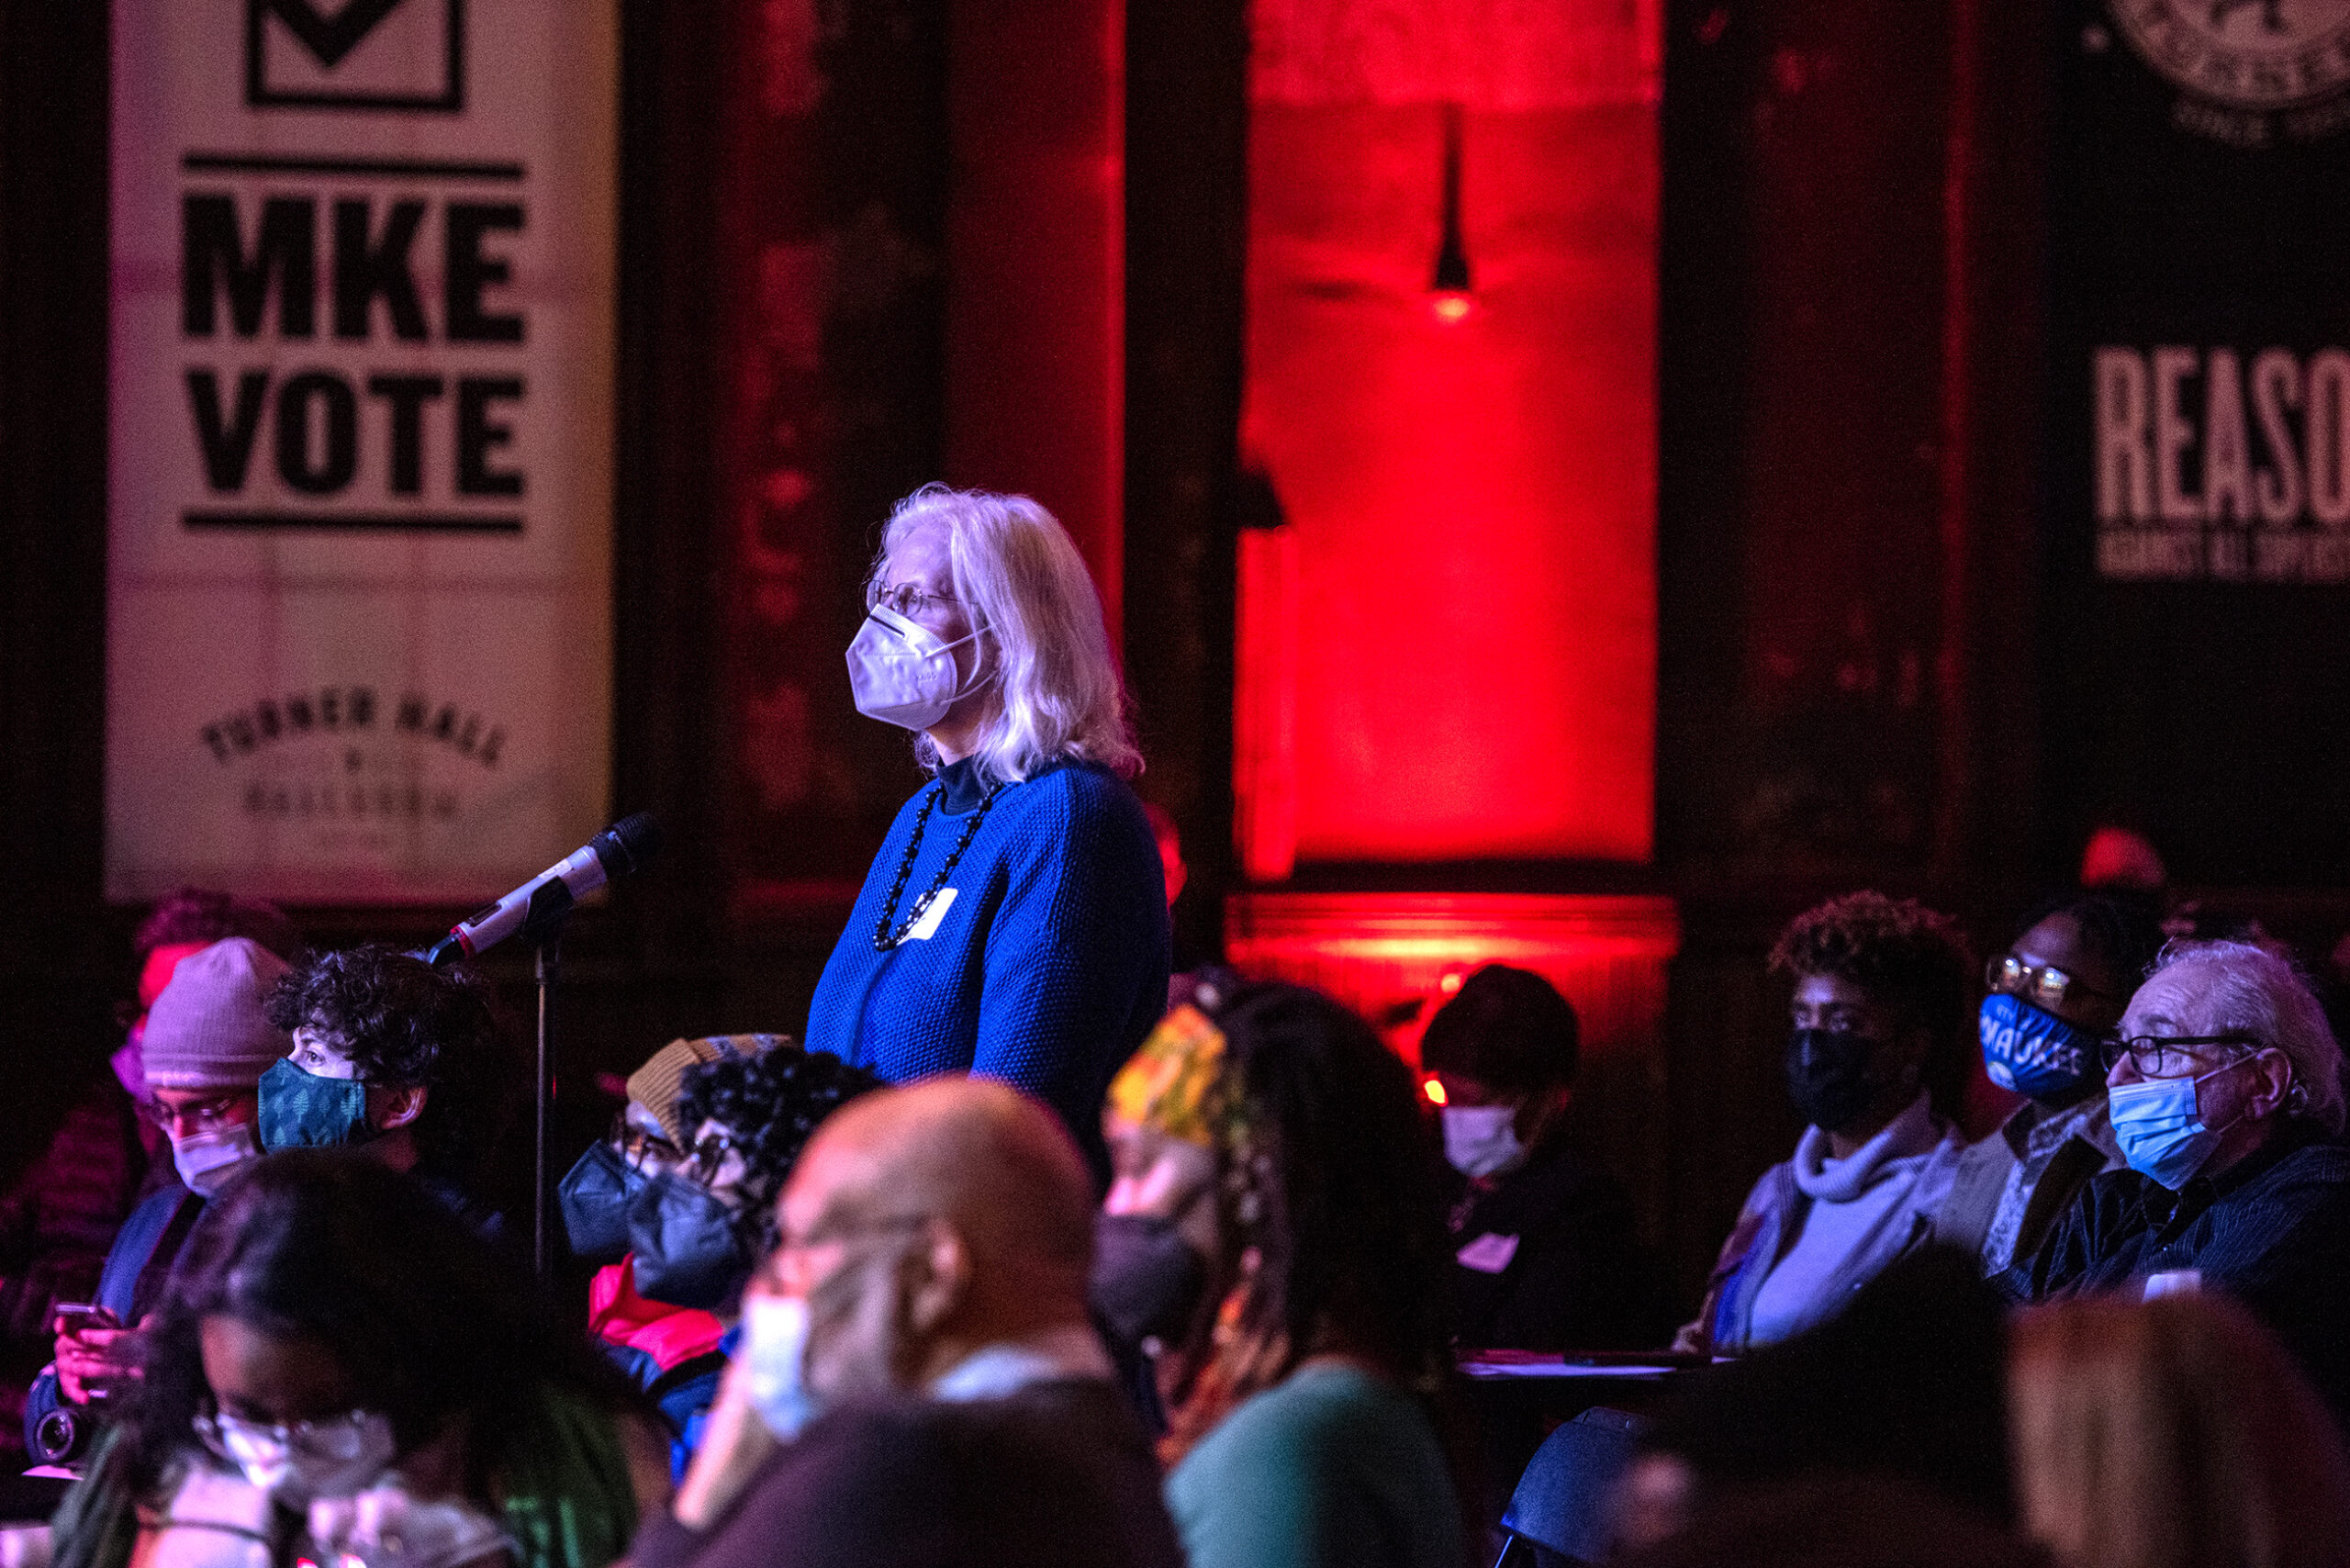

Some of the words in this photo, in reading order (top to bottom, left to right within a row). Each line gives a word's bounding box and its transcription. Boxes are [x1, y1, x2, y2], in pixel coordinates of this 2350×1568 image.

[183, 194, 524, 342] MKE
[186, 369, 524, 497] VOTE
[200, 685, 378, 765] TURNER
[396, 689, 507, 769] HALL
